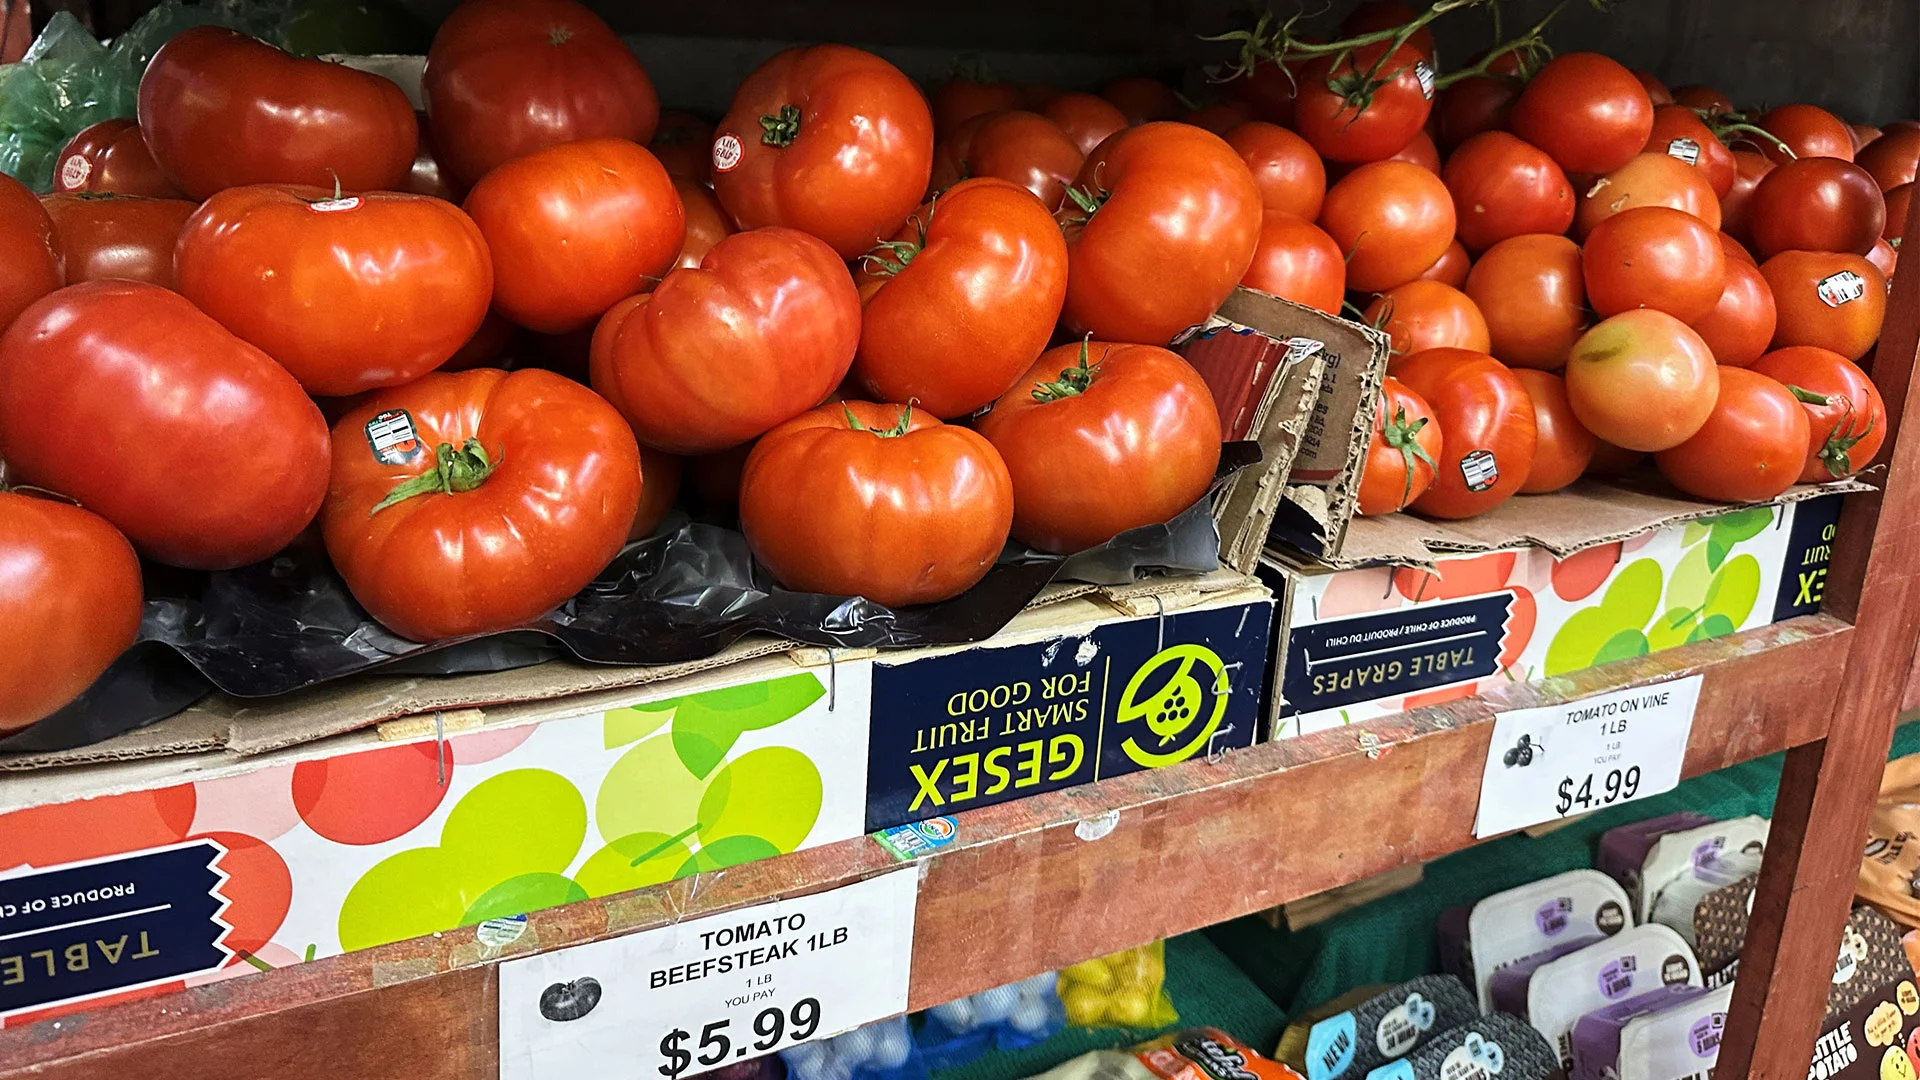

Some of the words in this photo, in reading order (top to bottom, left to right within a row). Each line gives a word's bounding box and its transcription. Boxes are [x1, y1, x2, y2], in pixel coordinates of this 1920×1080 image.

[1363, 627, 1399, 641] PRODUIT
[1405, 622, 1428, 635] CHILE
[1428, 620, 1440, 631] OF
[1441, 614, 1477, 629] PRODUCE
[1350, 633, 1363, 643] DU
[1409, 646, 1475, 677] TABLE
[1040, 670, 1092, 697] FOR
[1312, 660, 1403, 696] GRAPES
[946, 681, 1032, 717] GOOD
[1566, 703, 1618, 725] TOMATO
[1620, 698, 1641, 713] ON
[1642, 692, 1670, 709] VINE
[1000, 697, 1090, 736] SMART
[1599, 723, 1607, 736] 1
[1610, 719, 1628, 734] LB
[910, 715, 990, 754] FRUIT
[1611, 741, 1622, 750] LB
[907, 733, 1085, 813] GESEX
[1593, 755, 1607, 765] YOU
[1607, 753, 1622, 763] PAY
[1555, 765, 1642, 818] $4.99
[20, 899, 47, 915] OF
[51, 882, 136, 909] PRODUCE
[699, 911, 807, 951] TOMATO
[0, 930, 161, 986] TABLE
[649, 938, 800, 990] BEEFSTEAK
[807, 926, 850, 952] 1LB
[745, 979, 754, 989] 1
[757, 972, 774, 987] LB
[724, 995, 752, 1009] YOU
[753, 988, 777, 1003] PAY
[656, 996, 823, 1080] $5.99
[1322, 1029, 1351, 1072] NEW
